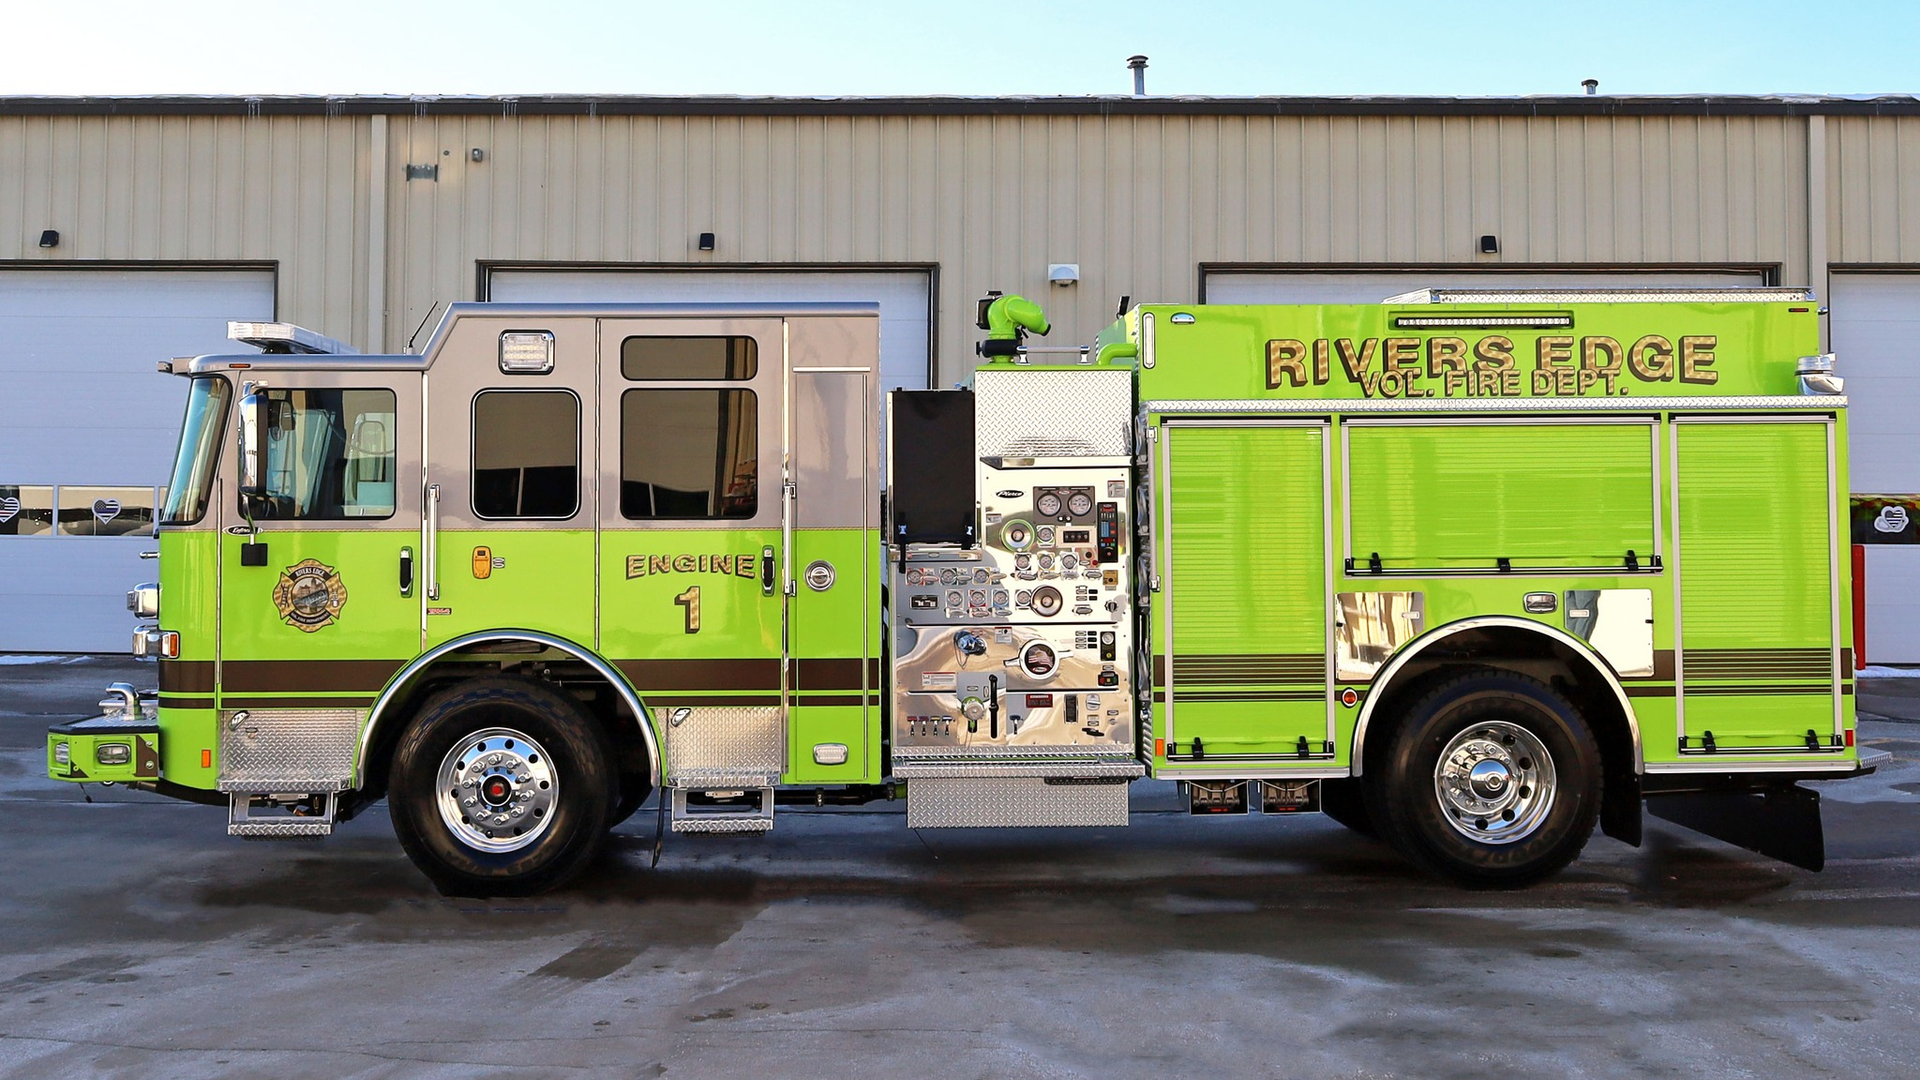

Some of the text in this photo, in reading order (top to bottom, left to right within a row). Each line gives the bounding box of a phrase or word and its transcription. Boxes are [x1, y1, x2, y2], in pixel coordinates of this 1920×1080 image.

[1265, 335, 1719, 388] RIVERS EDGE
[1358, 368, 1630, 398] VOL. FIRE DEPT.
[626, 554, 755, 579] ENGINE
[674, 585, 701, 634] 1
